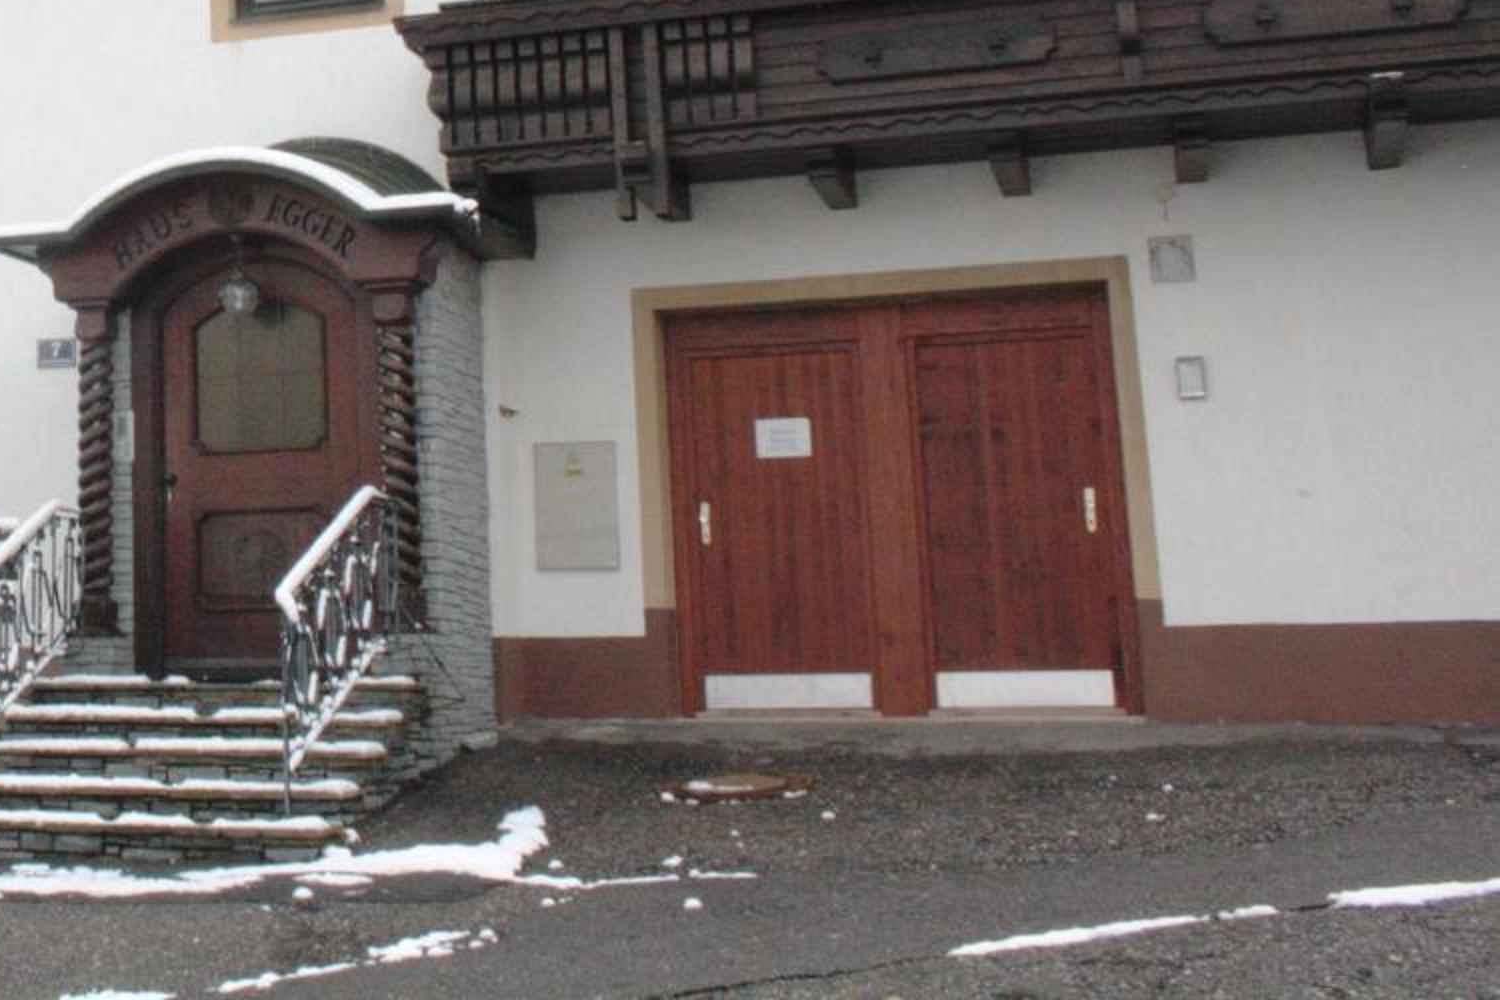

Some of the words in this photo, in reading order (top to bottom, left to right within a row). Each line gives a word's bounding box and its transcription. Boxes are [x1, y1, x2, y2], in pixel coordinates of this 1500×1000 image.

[110, 203, 195, 270] HAUS
[264, 194, 356, 257] EGGER
[51, 342, 61, 357] 7
